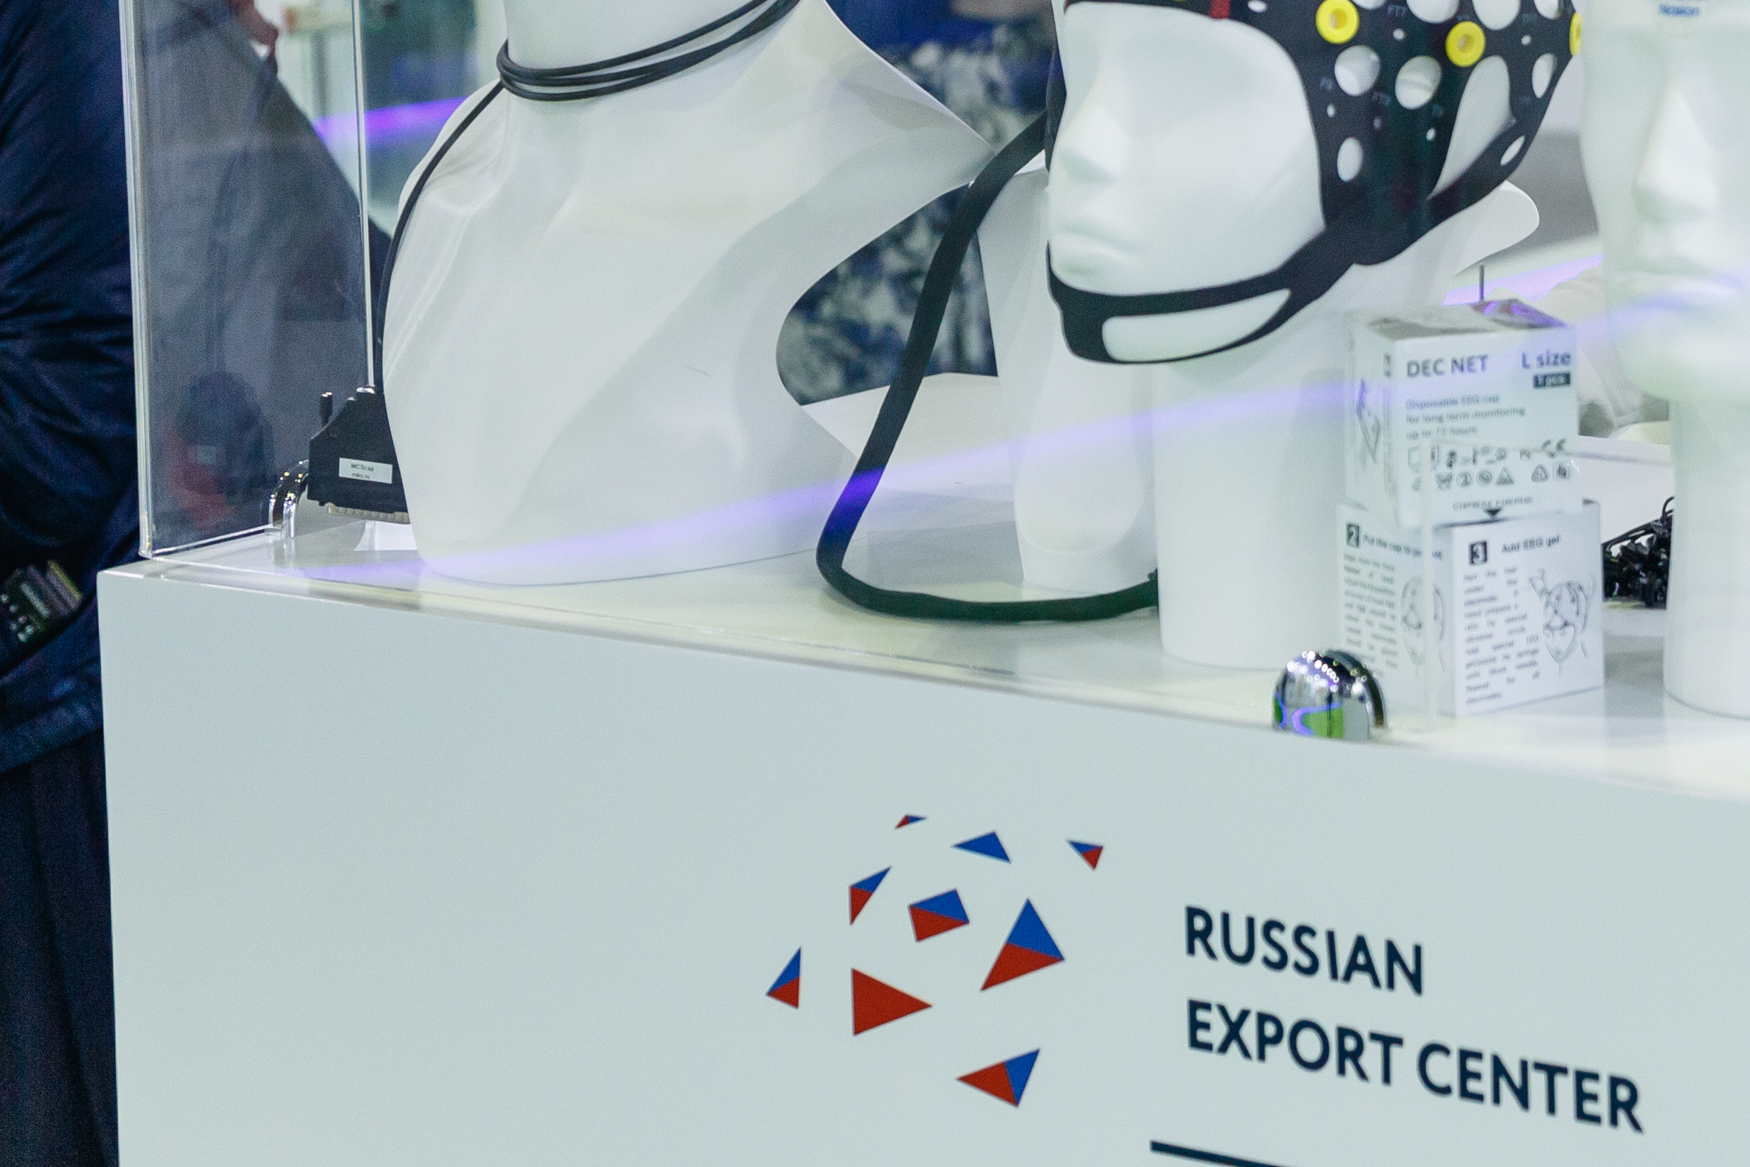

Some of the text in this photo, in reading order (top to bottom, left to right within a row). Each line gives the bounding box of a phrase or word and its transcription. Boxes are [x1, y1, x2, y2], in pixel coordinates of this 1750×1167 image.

[1405, 359, 1445, 377] DEC
[1450, 354, 1489, 374] NET
[1521, 351, 1531, 368] L
[1535, 348, 1572, 367] size
[1347, 525, 1359, 547] 2
[1471, 535, 1561, 565] 3 Add EEG gel
[1185, 905, 1423, 995] RUSSIAN
[1187, 999, 1644, 1134] EXPORT CENTER
